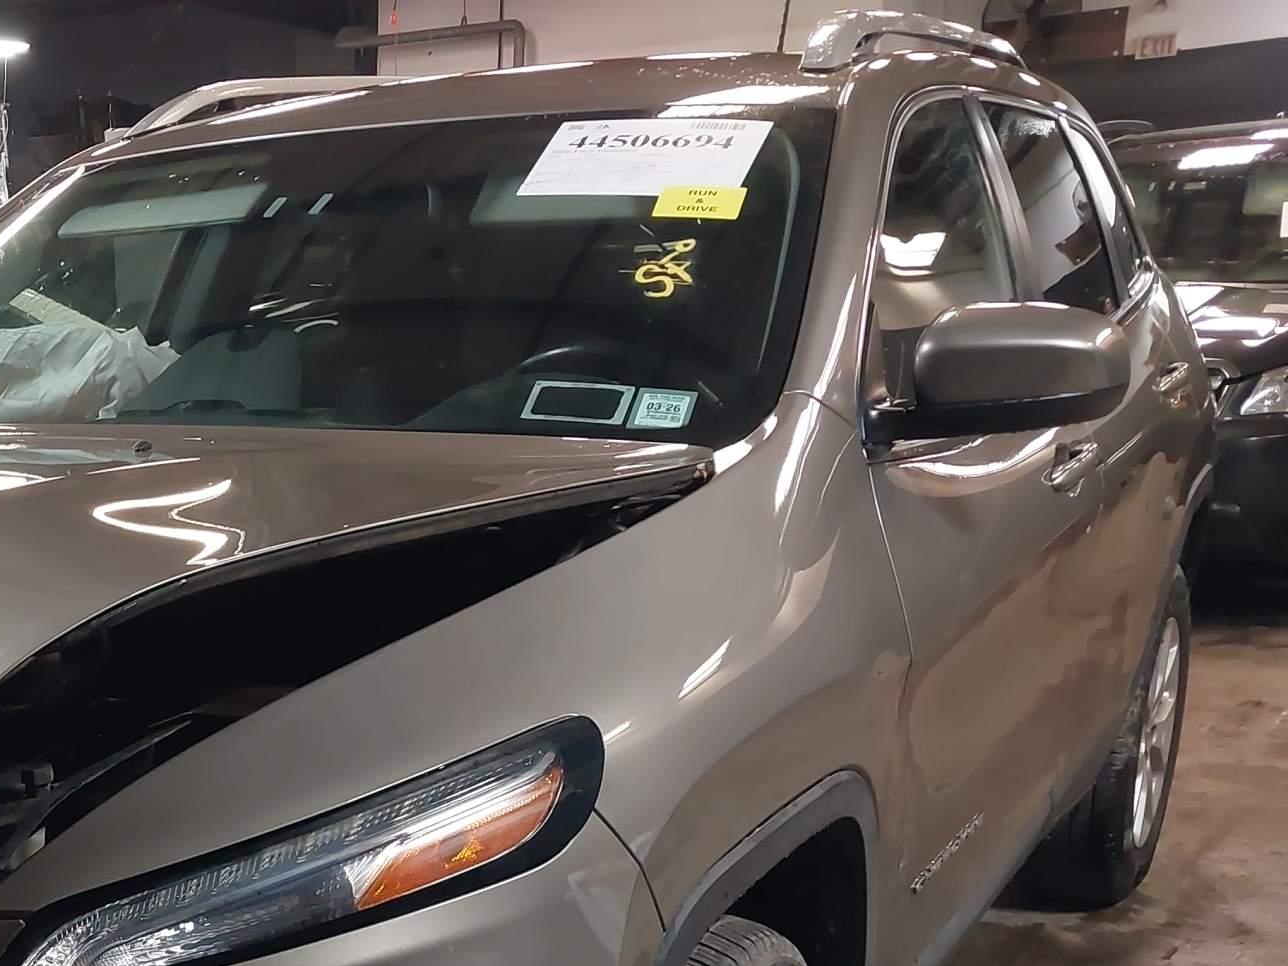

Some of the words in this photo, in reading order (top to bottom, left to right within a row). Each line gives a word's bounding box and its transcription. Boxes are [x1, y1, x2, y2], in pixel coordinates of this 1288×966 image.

[569, 133, 734, 150] 44506694
[646, 402, 662, 411] 03
[665, 403, 681, 413] 26
